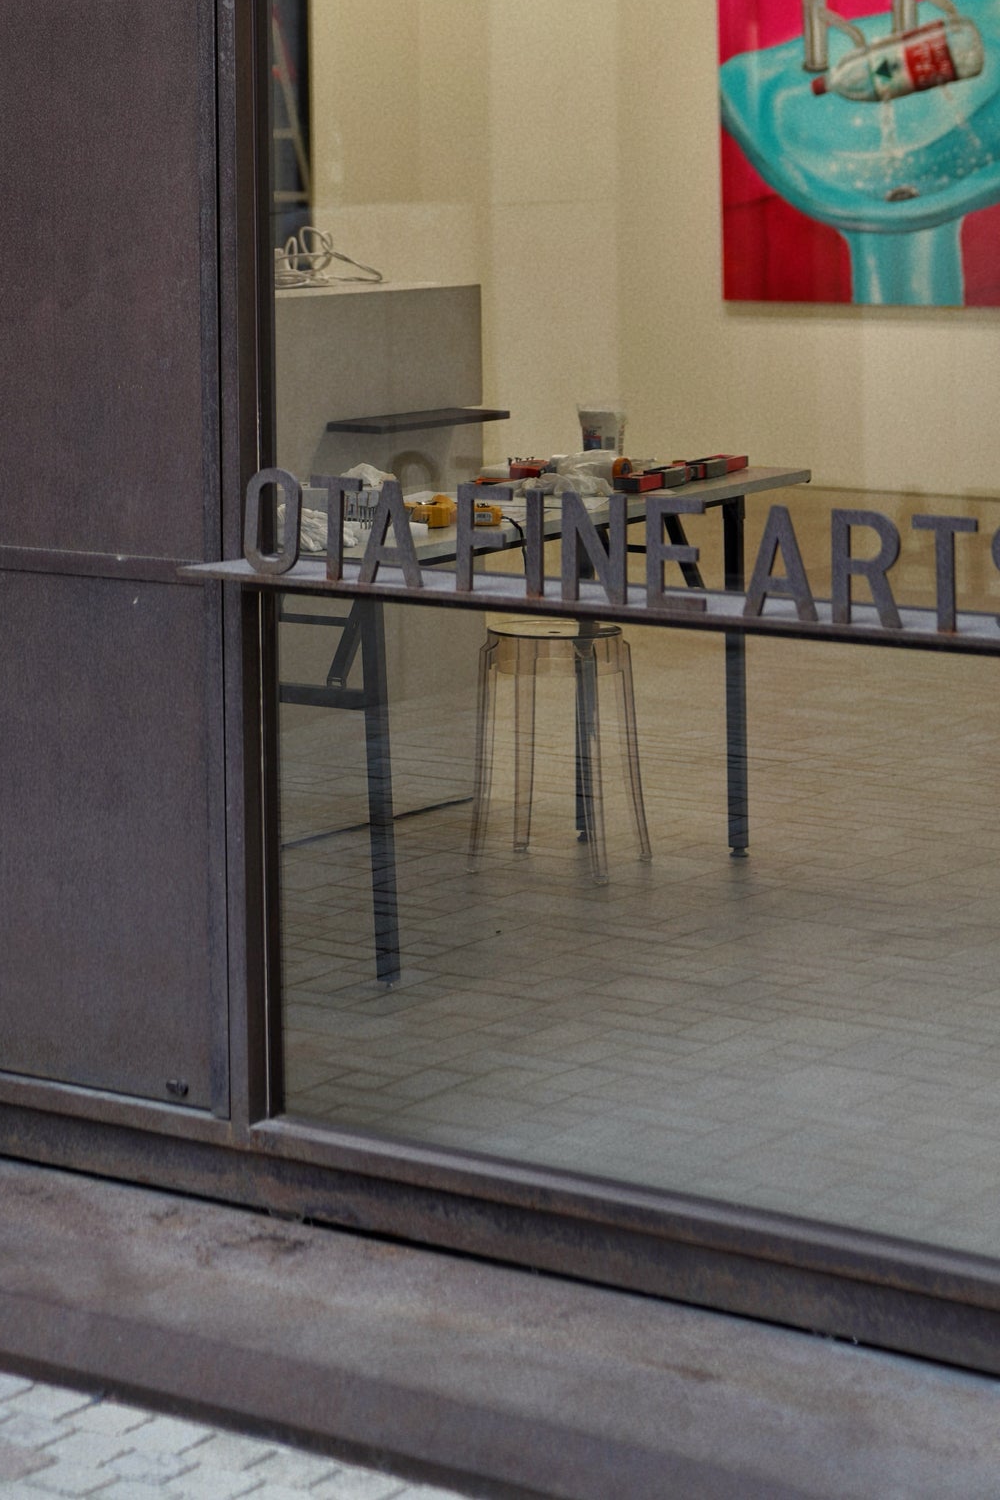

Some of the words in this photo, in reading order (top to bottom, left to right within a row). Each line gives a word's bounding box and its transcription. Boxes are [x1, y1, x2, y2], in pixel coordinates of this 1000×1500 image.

[244, 467, 424, 587] OTA
[456, 483, 707, 613] FINE
[743, 505, 1000, 632] ART
